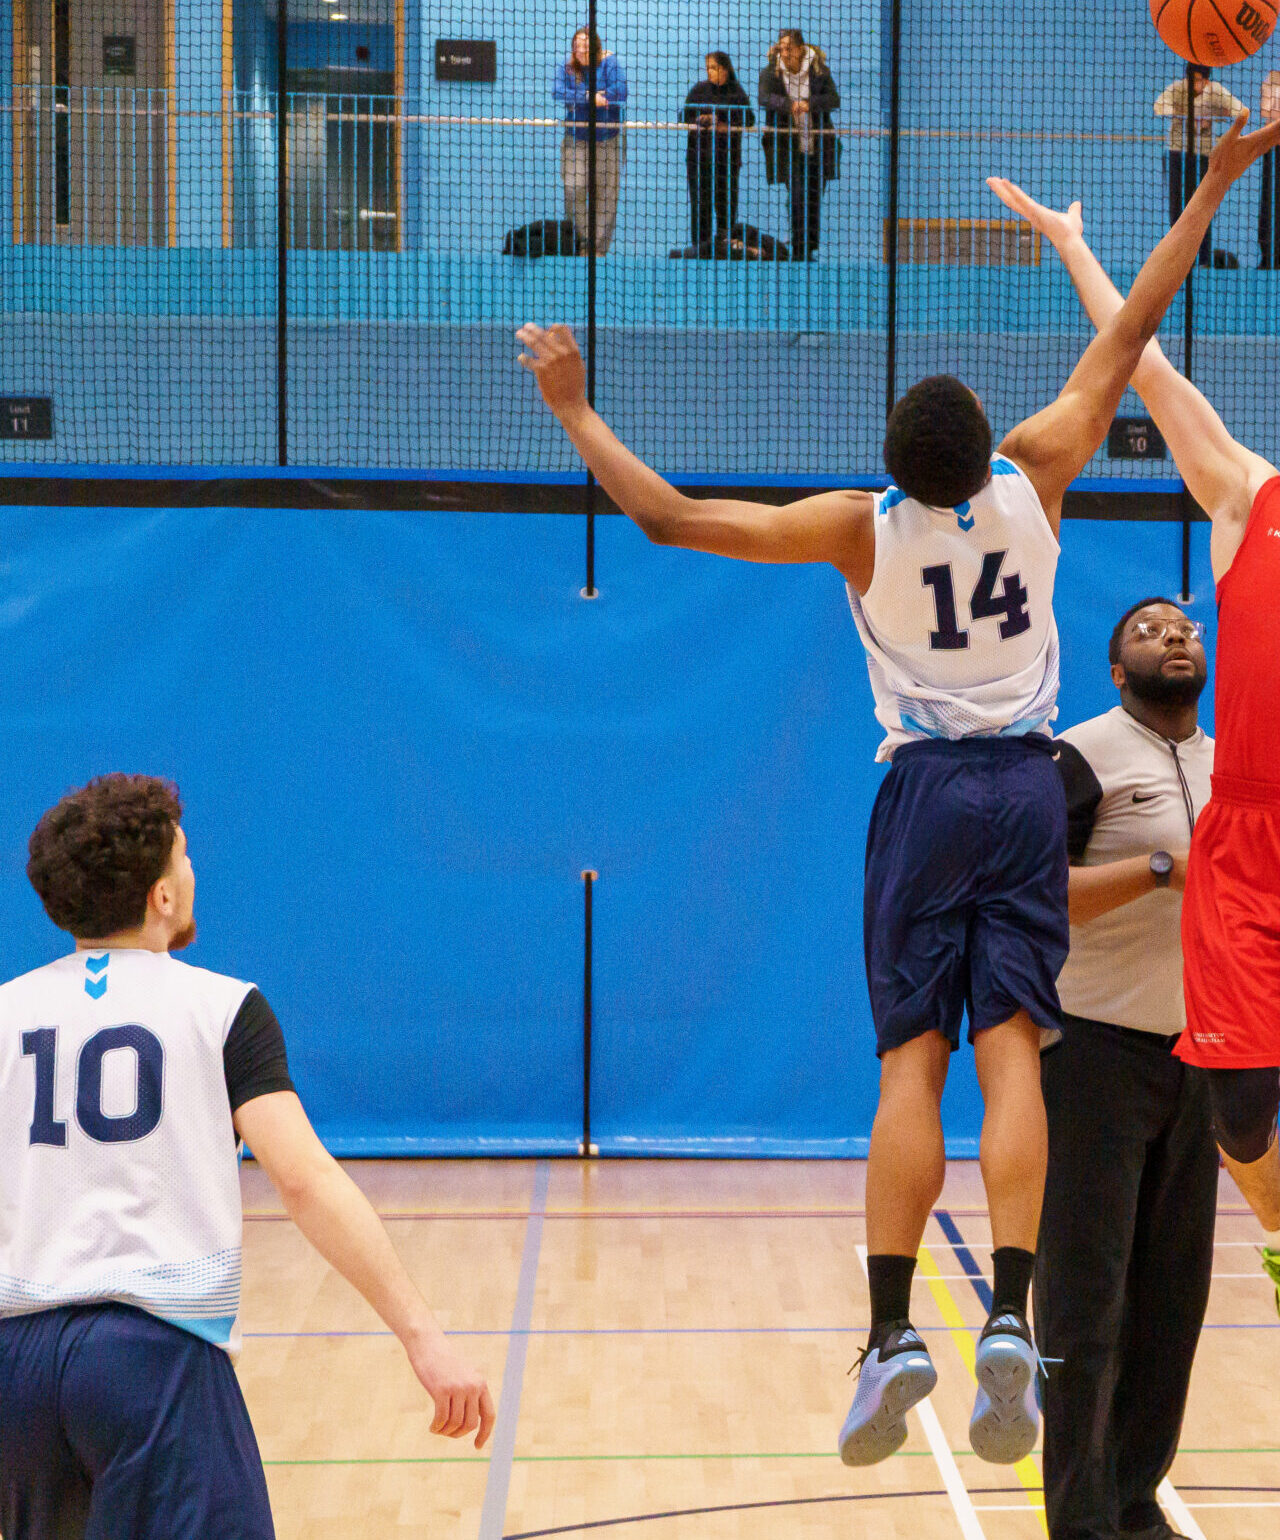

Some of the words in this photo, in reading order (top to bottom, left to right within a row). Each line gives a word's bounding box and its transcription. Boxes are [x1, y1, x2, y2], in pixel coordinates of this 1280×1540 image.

[12, 418, 28, 432] 11
[1128, 437, 1147, 452] 10
[920, 548, 1032, 652] 14
[19, 1022, 166, 1149] 10
